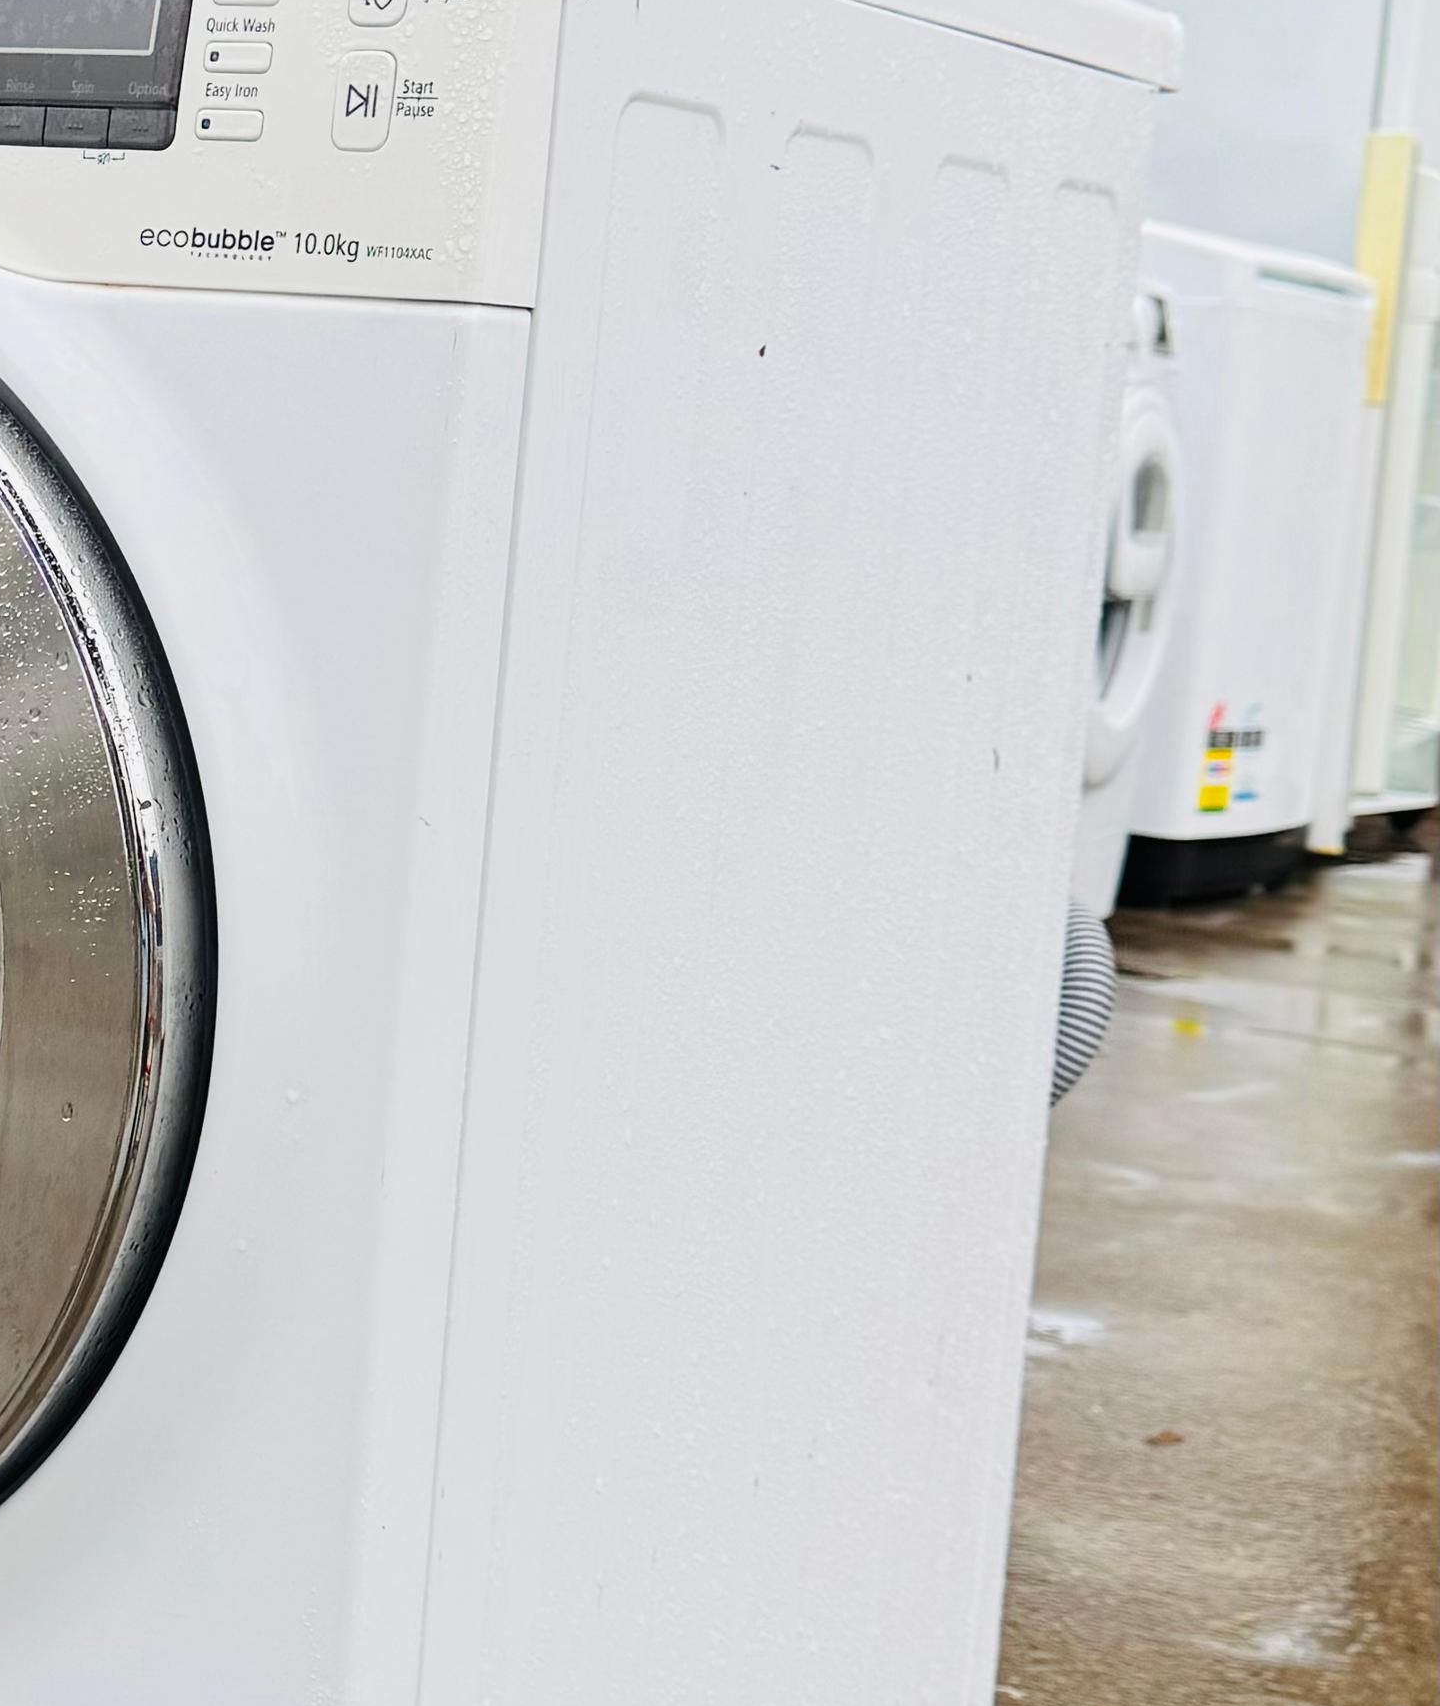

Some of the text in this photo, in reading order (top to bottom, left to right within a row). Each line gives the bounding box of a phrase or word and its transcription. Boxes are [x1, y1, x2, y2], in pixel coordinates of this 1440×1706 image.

[206, 17, 276, 34] Quick Wash
[205, 82, 259, 102] Easy Iron
[402, 78, 433, 95] Start
[395, 101, 435, 118] Pause
[294, 231, 360, 263] 10.0kg
